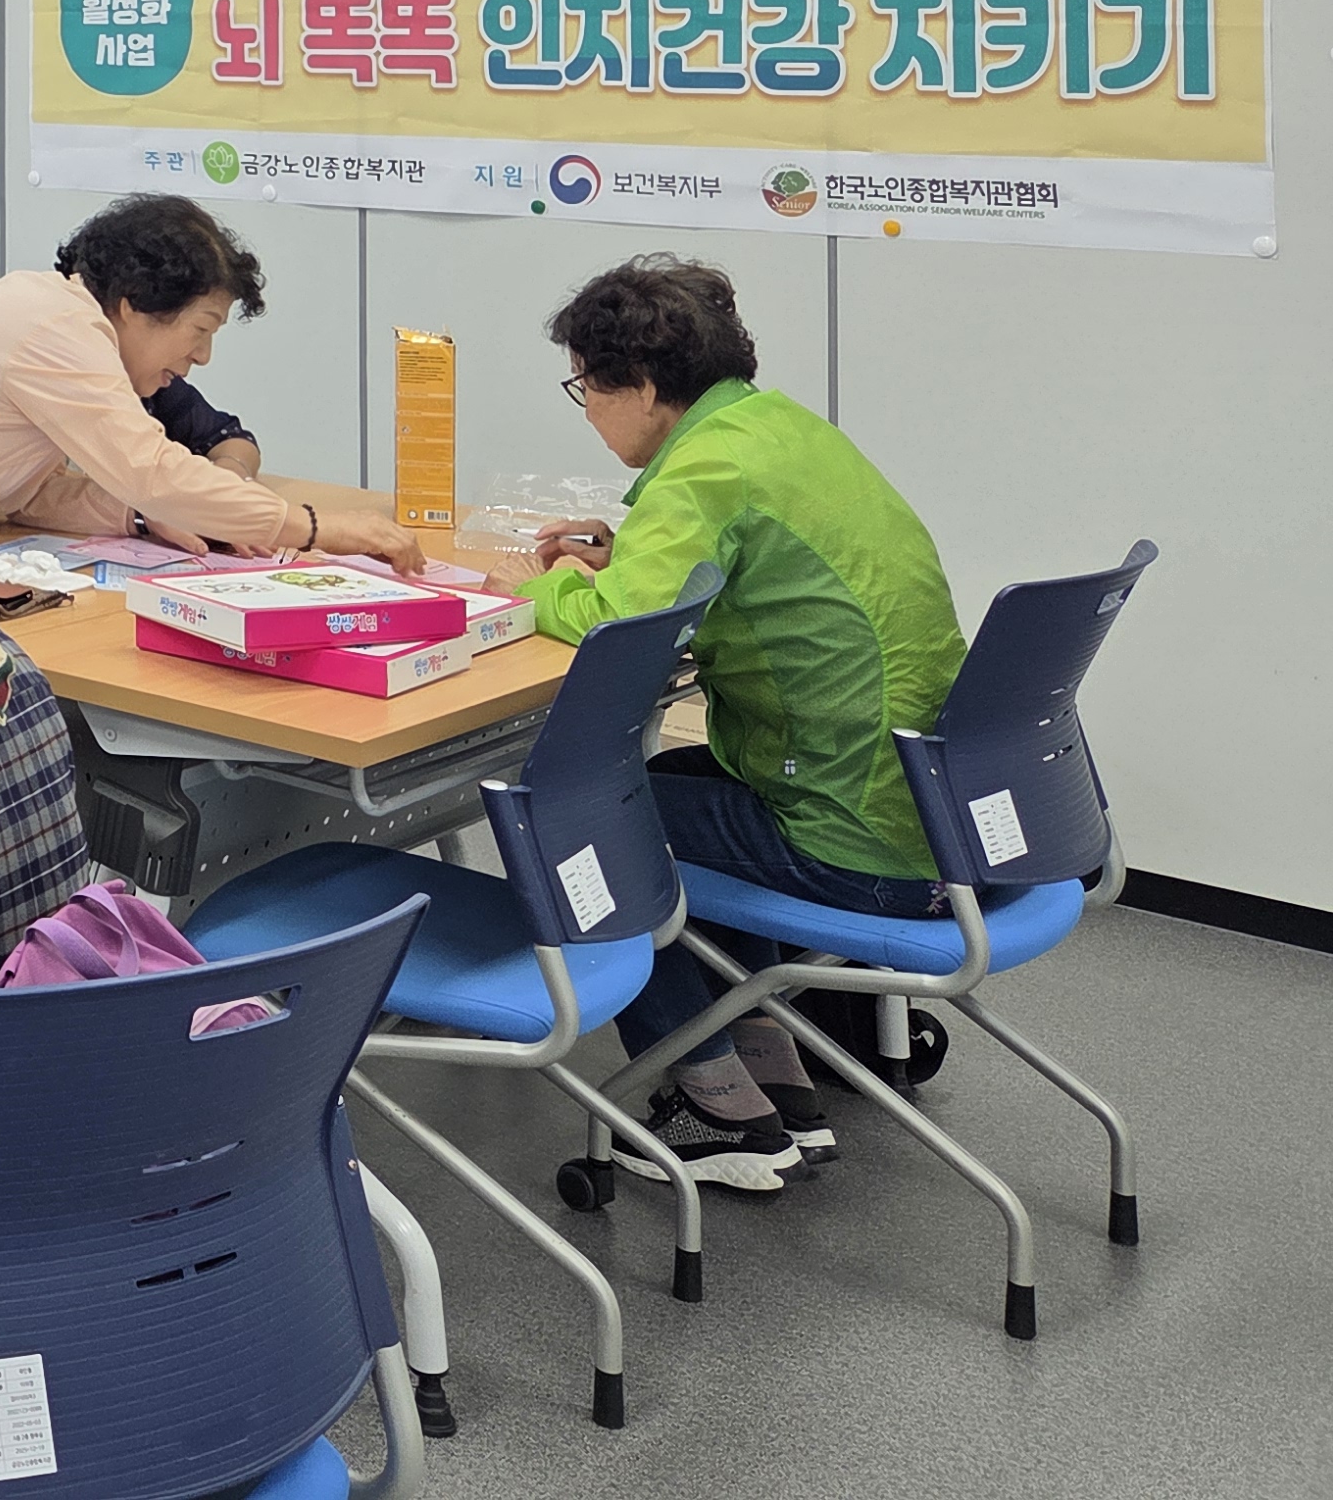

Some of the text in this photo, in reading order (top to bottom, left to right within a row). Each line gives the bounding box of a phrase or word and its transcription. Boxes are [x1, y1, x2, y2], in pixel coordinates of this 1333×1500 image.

[96, 33, 155, 67] 사업
[240, 153, 426, 183] 금강노인종합복지관
[612, 172, 722, 198] 보건복지부
[825, 174, 1059, 209] 한국노인종합복지관협회
[771, 195, 811, 210] Senior
[827, 202, 1046, 219] KOREA ASSOCIATION OF SENIOR WELFARE CENTERS
